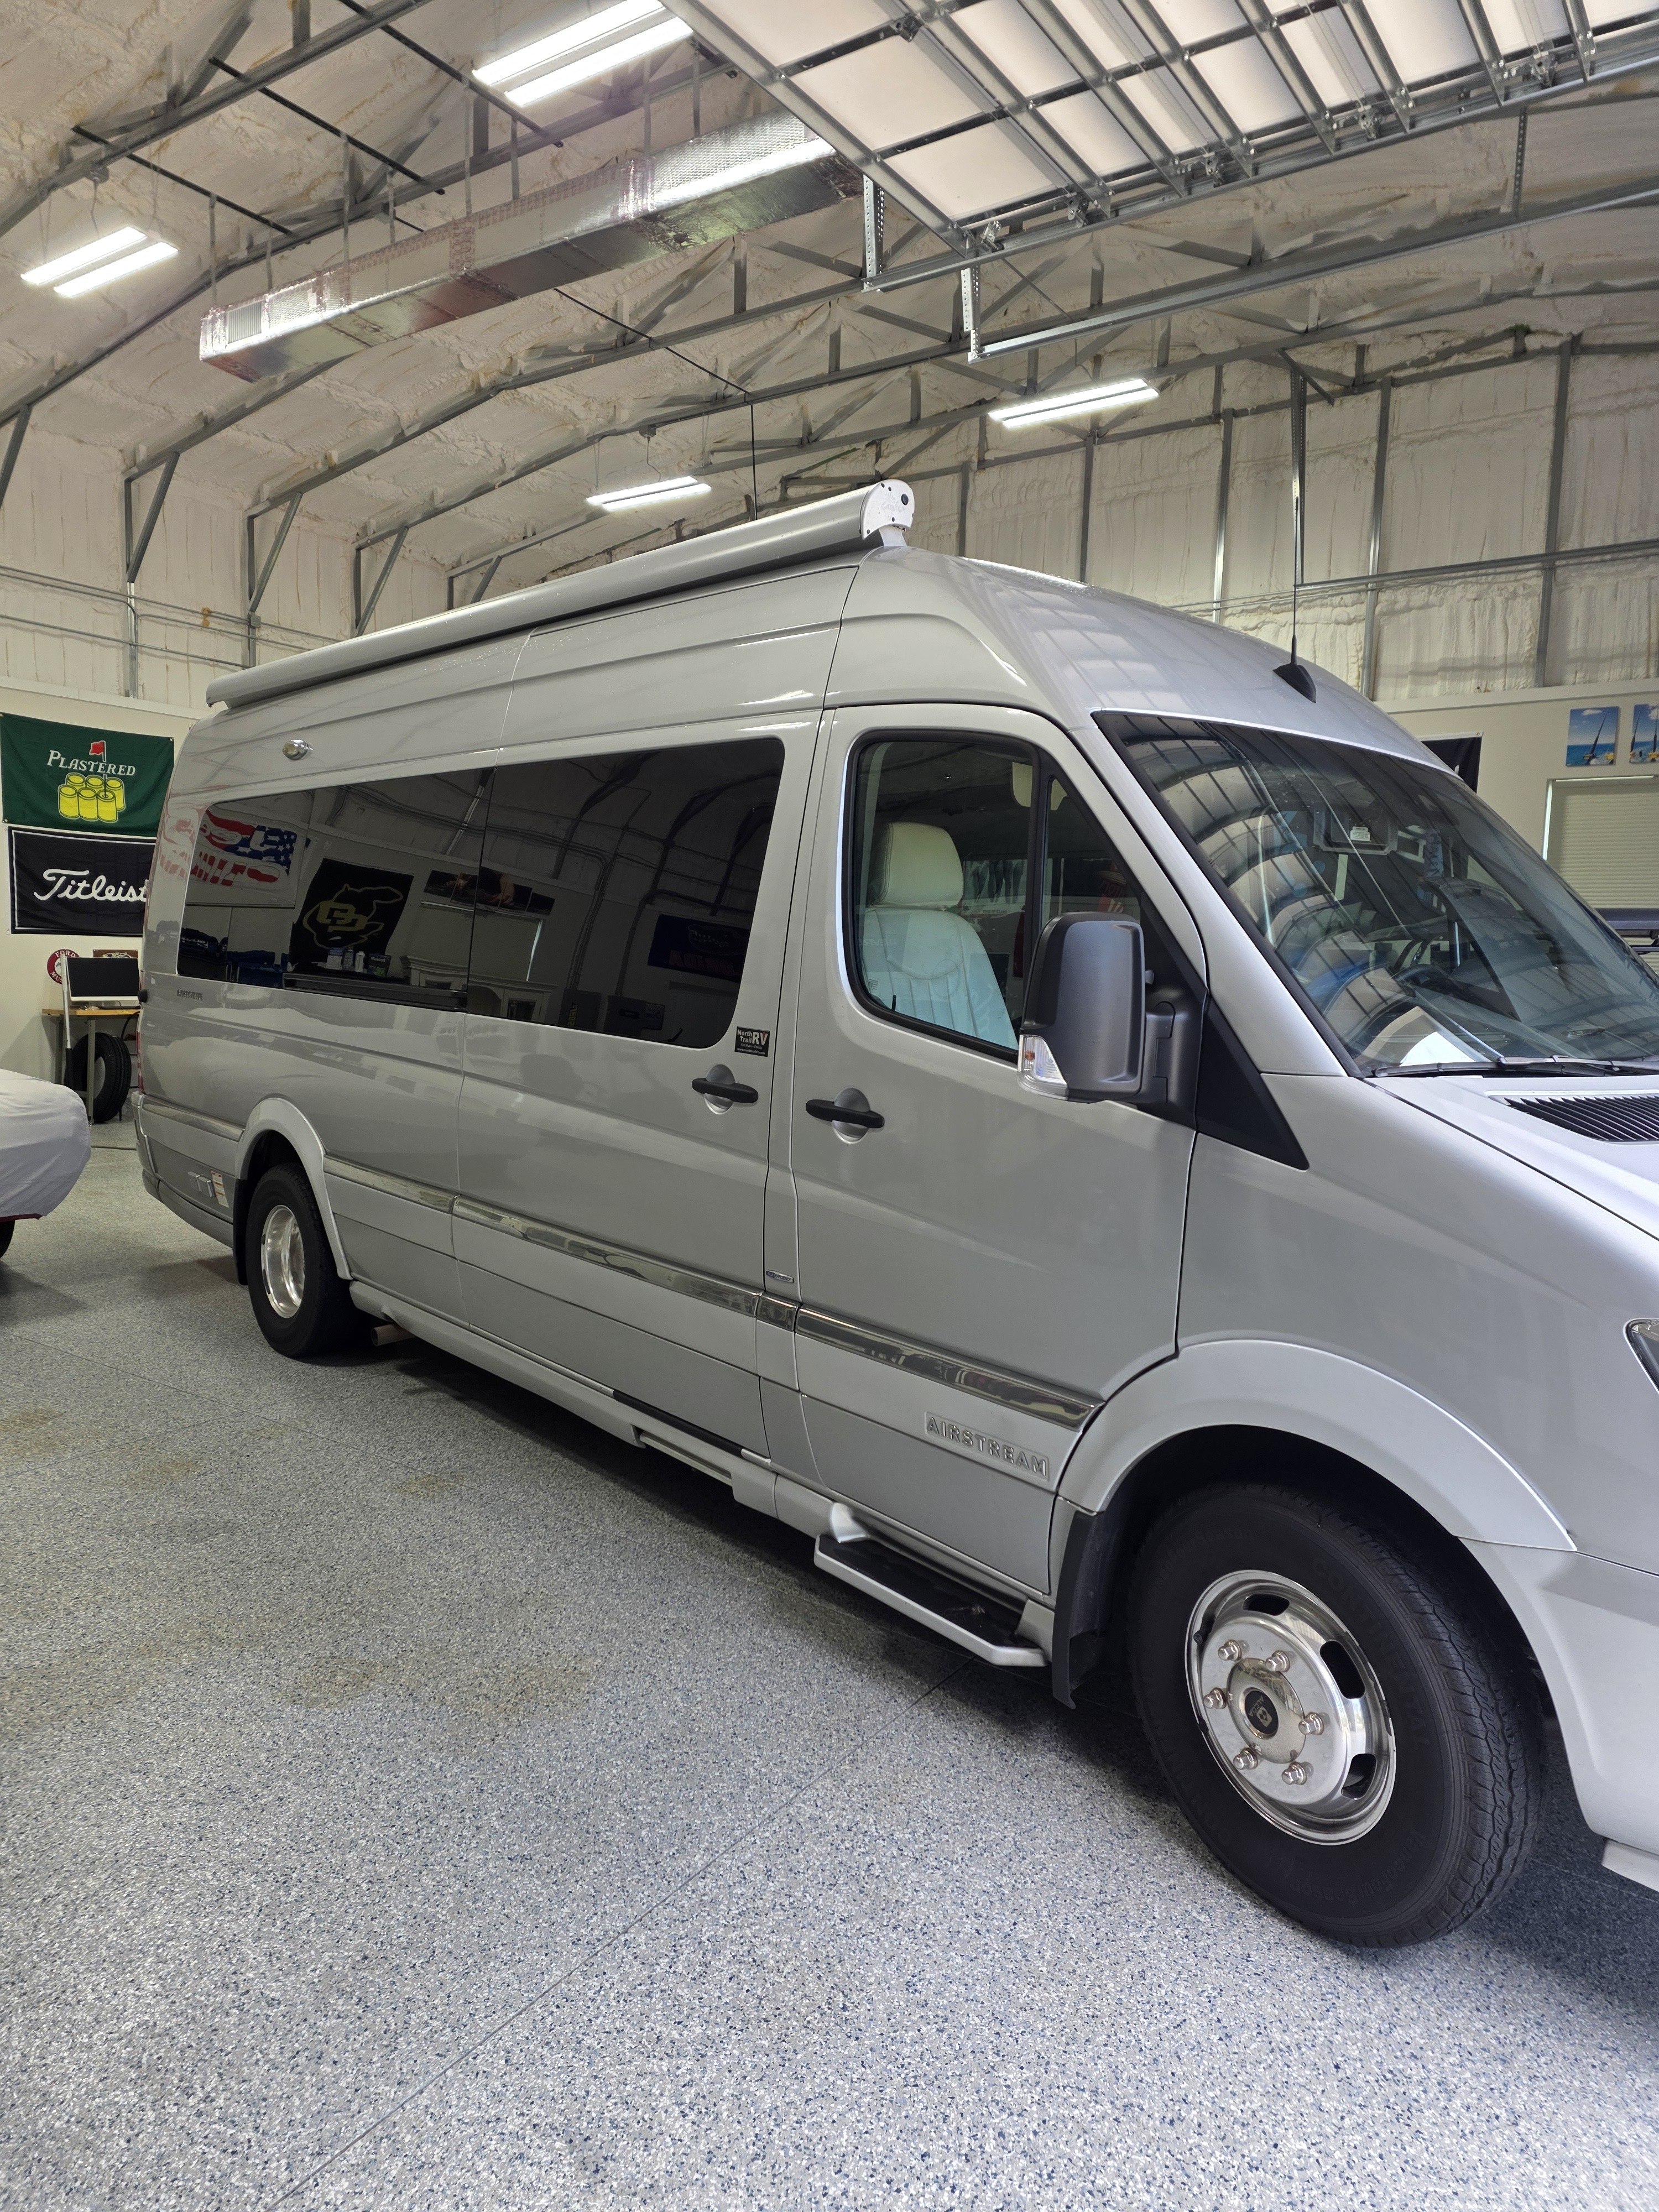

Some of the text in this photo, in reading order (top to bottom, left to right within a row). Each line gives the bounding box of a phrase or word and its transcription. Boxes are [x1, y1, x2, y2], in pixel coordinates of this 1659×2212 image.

[46, 749, 135, 776] PLASTERED
[752, 1031, 768, 1045] RV
[926, 1416, 1046, 1477] AIRSTREAM
[1248, 1695, 1264, 1717] ALCOA
